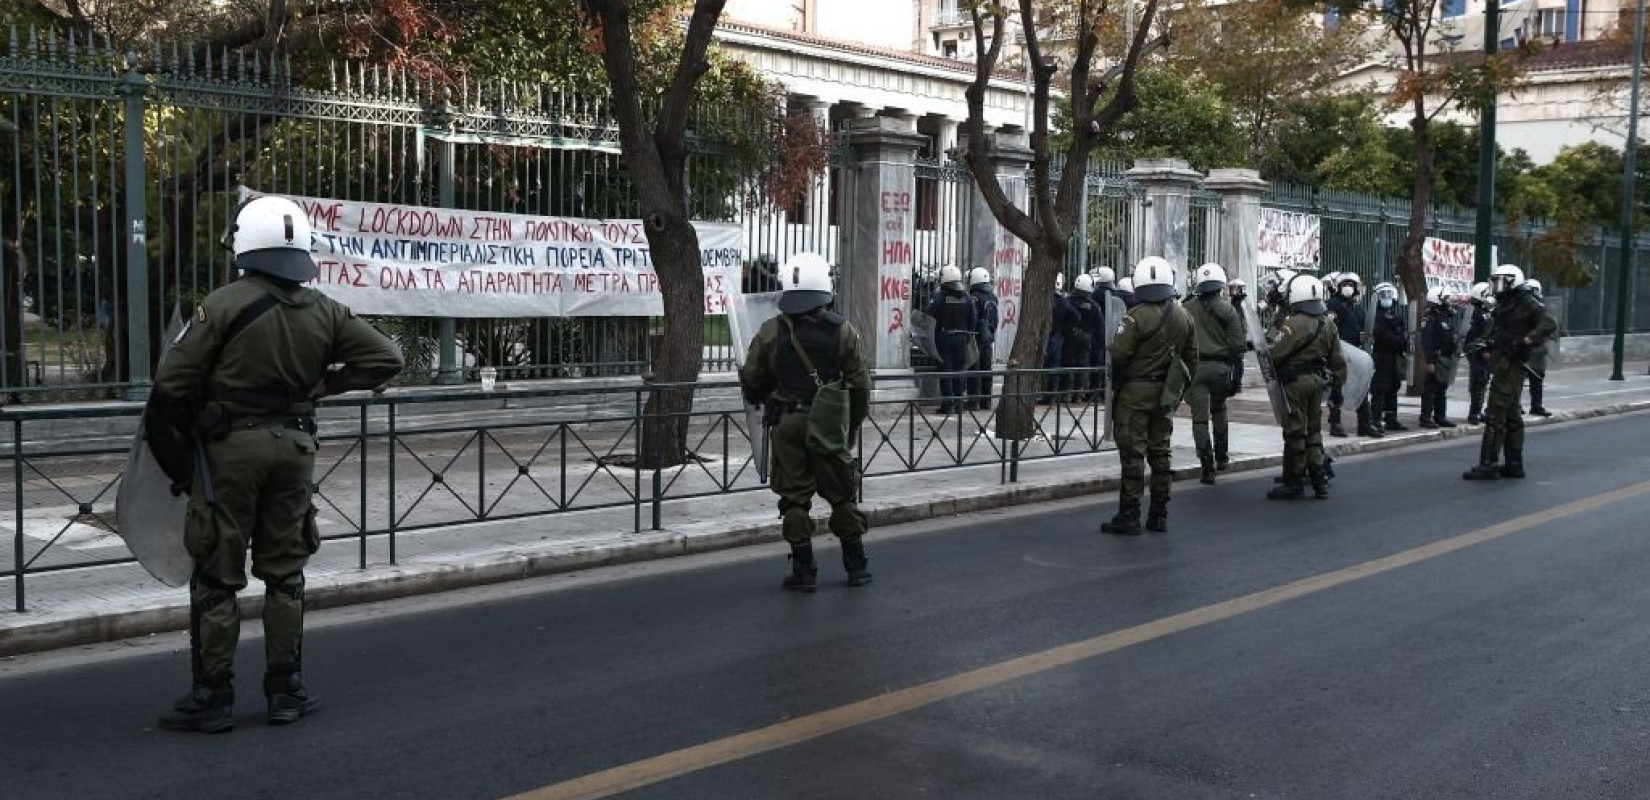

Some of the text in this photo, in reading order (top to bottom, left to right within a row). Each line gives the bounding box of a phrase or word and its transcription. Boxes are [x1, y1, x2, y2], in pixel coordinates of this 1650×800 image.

[295, 200, 343, 231] ΥΜΕ
[359, 206, 463, 238] LOCKDOWN
[470, 216, 512, 241] ΣΤΗΝ
[600, 223, 643, 243] ΤΟΥΣ
[546, 246, 605, 268] ΠΟΡΕΙΑ
[611, 247, 649, 267] ΤΡΙΤ
[701, 247, 742, 268] ΟΕΜΒΡΗ
[882, 240, 911, 265] ΗΠΑ
[309, 260, 368, 287] ΝΤΑΣ
[380, 266, 417, 291] ΟΛΑ
[422, 267, 446, 290] ΤΑ
[457, 270, 563, 294] ΑΠΑΡΑΙΤΗΤΑ
[573, 273, 630, 293] ΜΕΤΡΑ
[881, 275, 910, 301] ΚΚΕ
